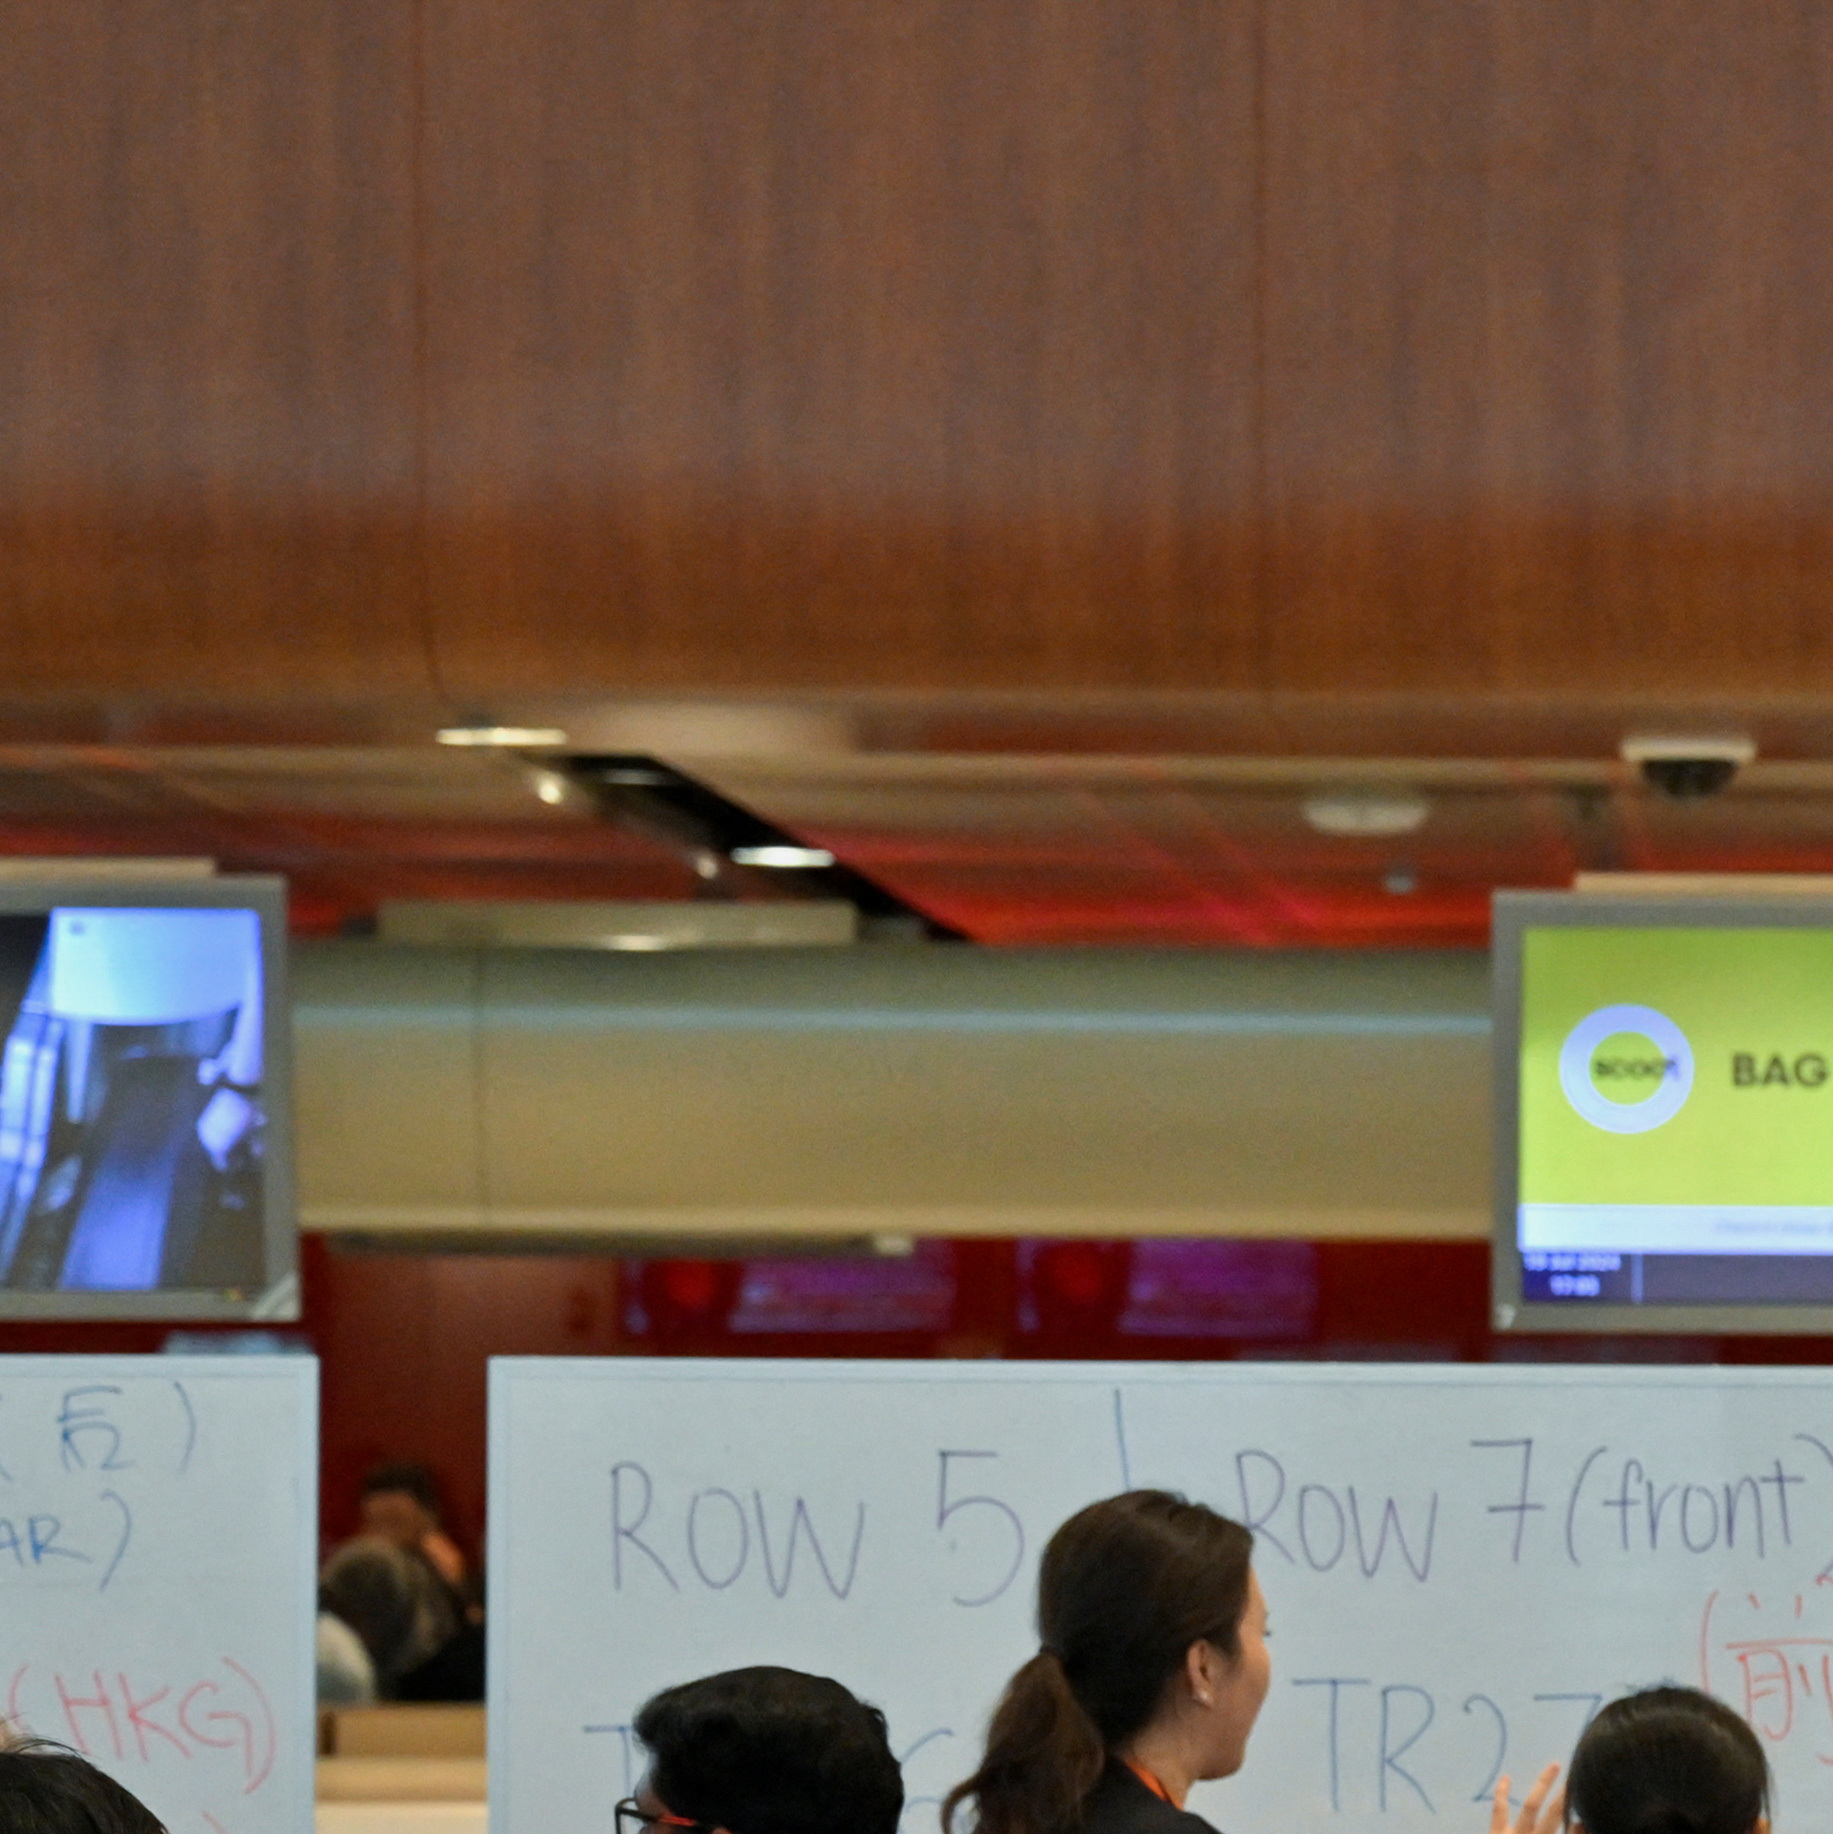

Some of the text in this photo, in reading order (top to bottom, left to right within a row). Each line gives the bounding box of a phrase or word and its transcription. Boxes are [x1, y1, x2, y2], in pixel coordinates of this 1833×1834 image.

[1732, 1051, 1830, 1089] BAG
[936, 1448, 1026, 1608] 5
[8, 1655, 277, 1795] (HKG)
